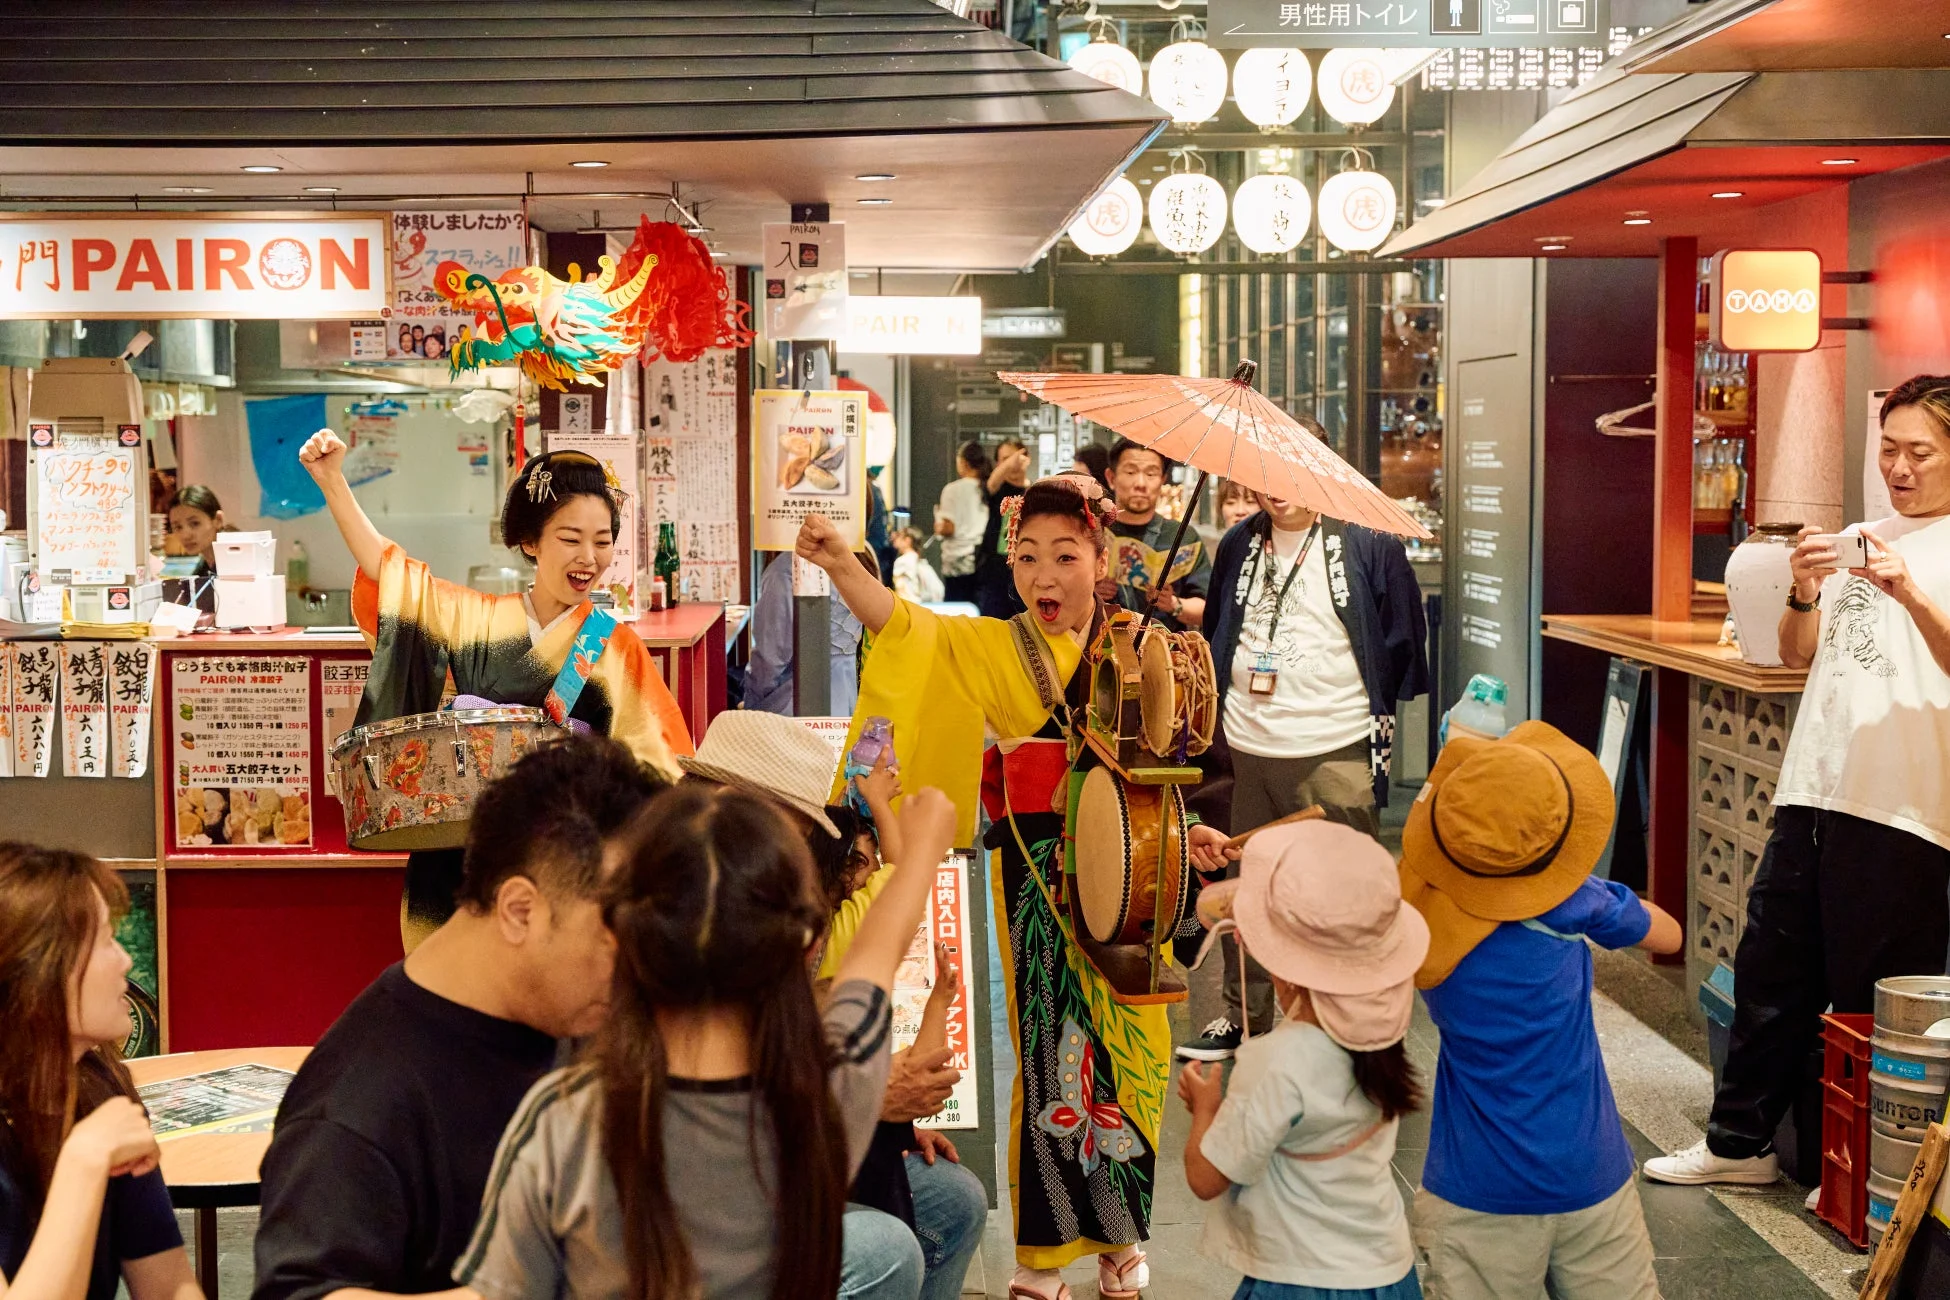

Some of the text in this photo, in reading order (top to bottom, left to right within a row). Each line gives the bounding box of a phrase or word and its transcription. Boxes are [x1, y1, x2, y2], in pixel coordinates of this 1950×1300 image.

[1278, 3, 1418, 27] 男性用トイレ
[71, 238, 371, 292] PAIRON
[1726, 289, 1816, 313] TAMA
[64, 704, 105, 713] PAIRON
[226, 763, 302, 774] 五大餃子セット
[936, 871, 957, 938] 店内入口
[946, 1112, 960, 1122] 380
